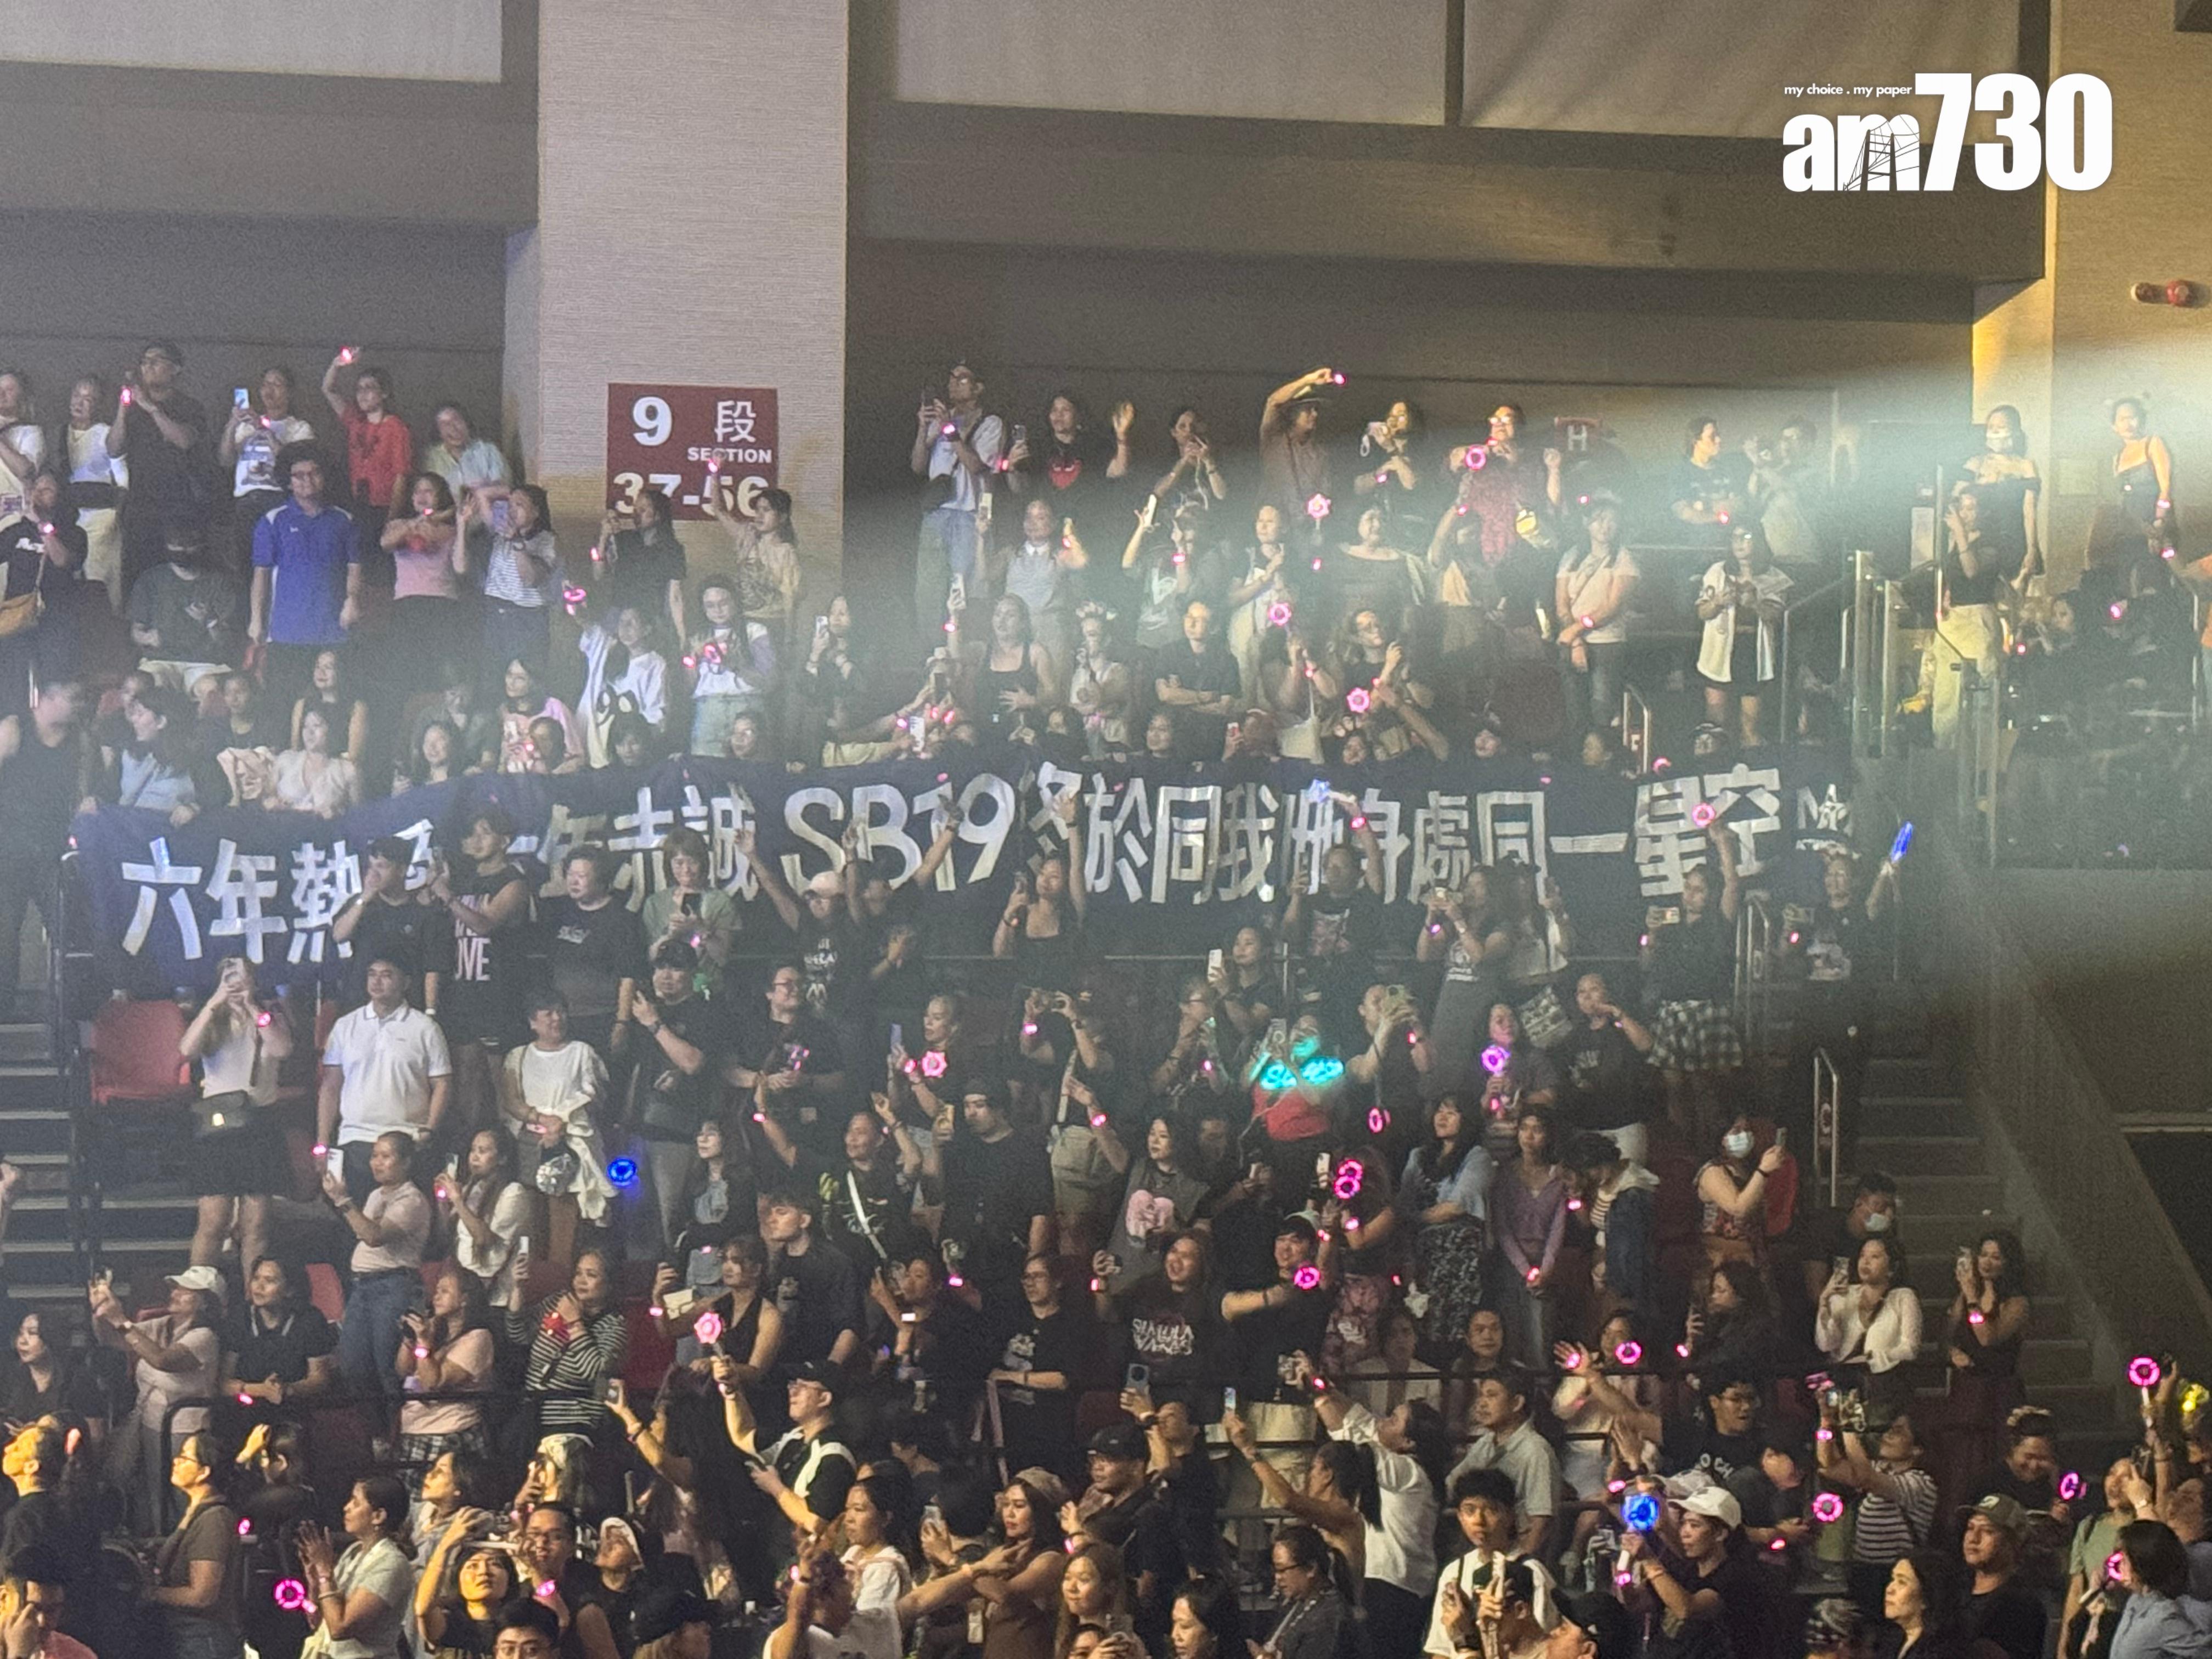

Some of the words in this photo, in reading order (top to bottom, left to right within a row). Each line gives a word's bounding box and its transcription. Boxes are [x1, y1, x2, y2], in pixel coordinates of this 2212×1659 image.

[633, 396, 673, 446] 9
[714, 400, 757, 443] 段
[1567, 425, 1588, 452] H
[687, 447, 772, 464] SETION
[613, 472, 769, 517] 37-56
[780, 772, 1016, 899] SB19
